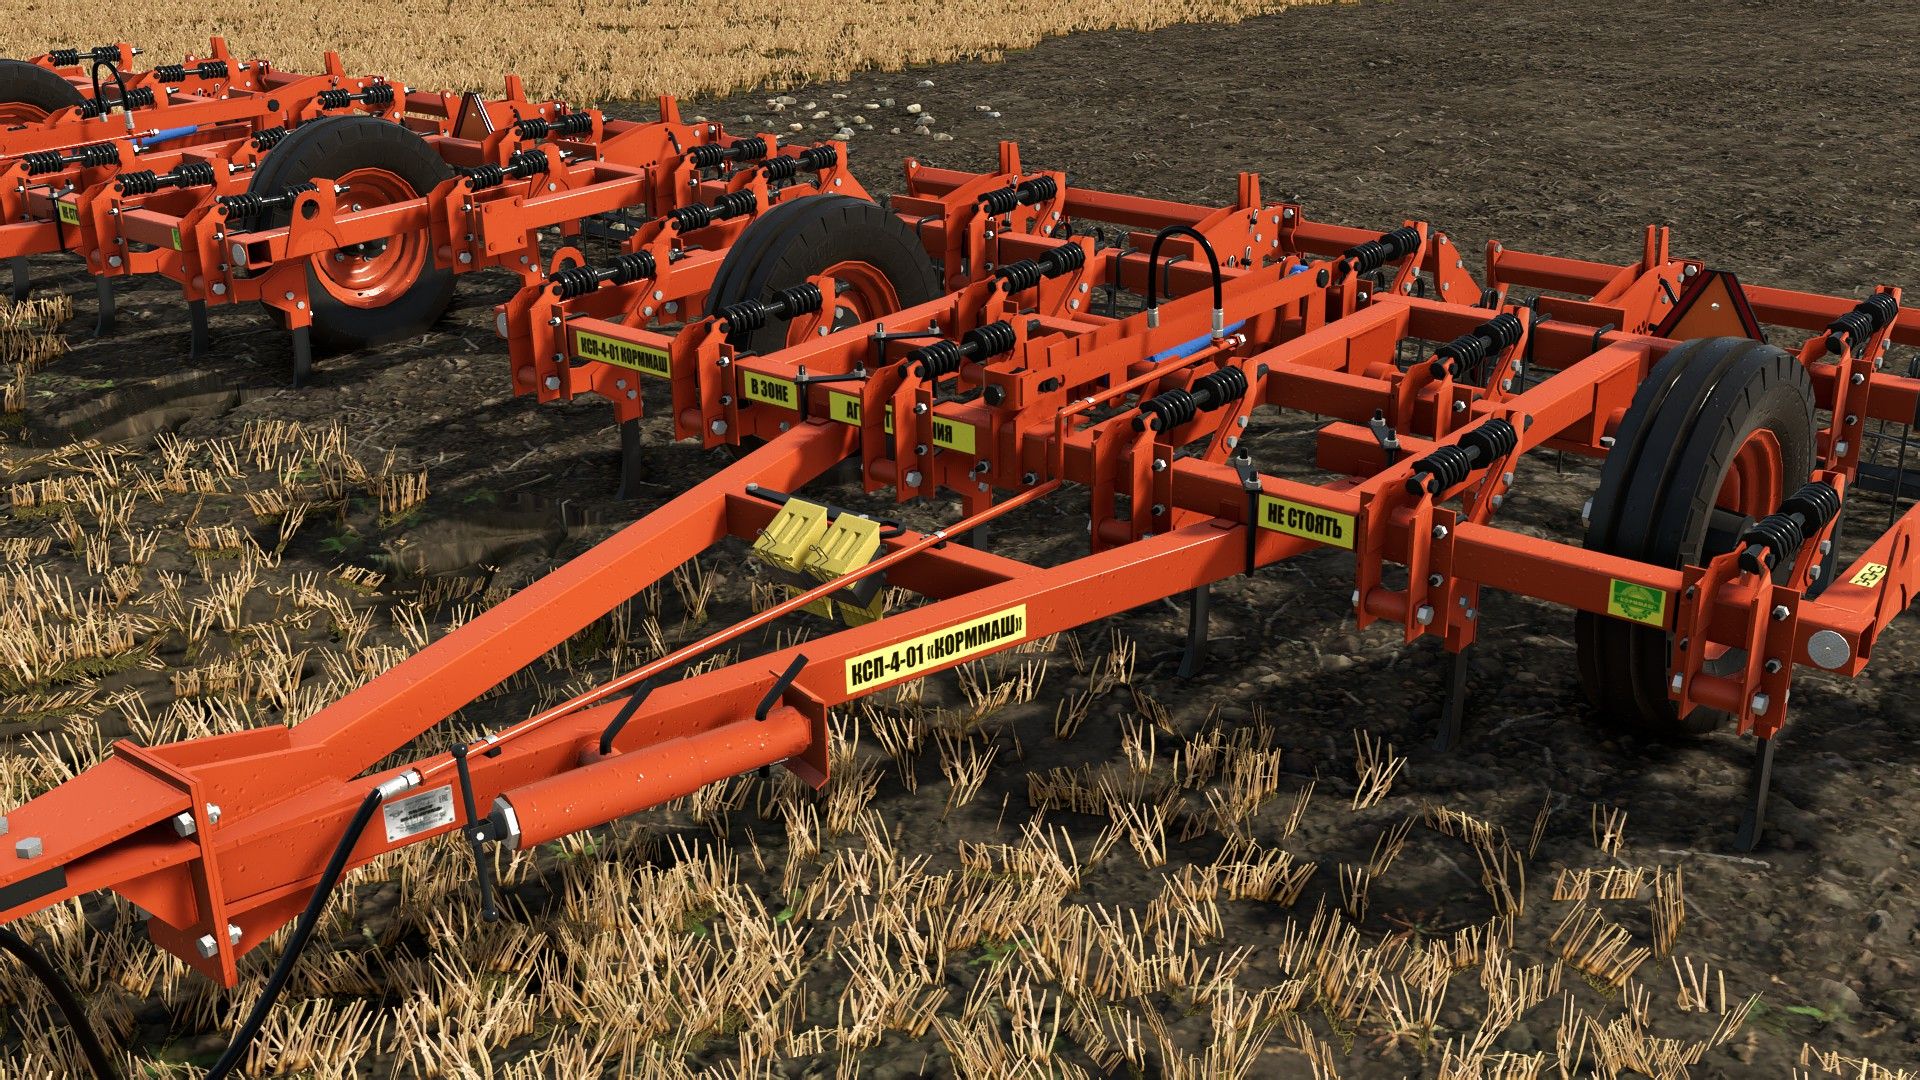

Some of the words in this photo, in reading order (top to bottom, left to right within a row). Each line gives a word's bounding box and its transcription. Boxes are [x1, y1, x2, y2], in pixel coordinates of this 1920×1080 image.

[581, 337, 619, 360] КСП-4-01
[620, 347, 667, 373] КОРММАШ
[751, 378, 758, 394] В
[761, 380, 788, 402] ЗОНЕ
[1268, 503, 1284, 525] НЕ
[1288, 507, 1342, 539] СТОЯТЬ
[852, 643, 923, 686] КСП-4-01
[927, 614, 1022, 660] «КОРММАШ»
